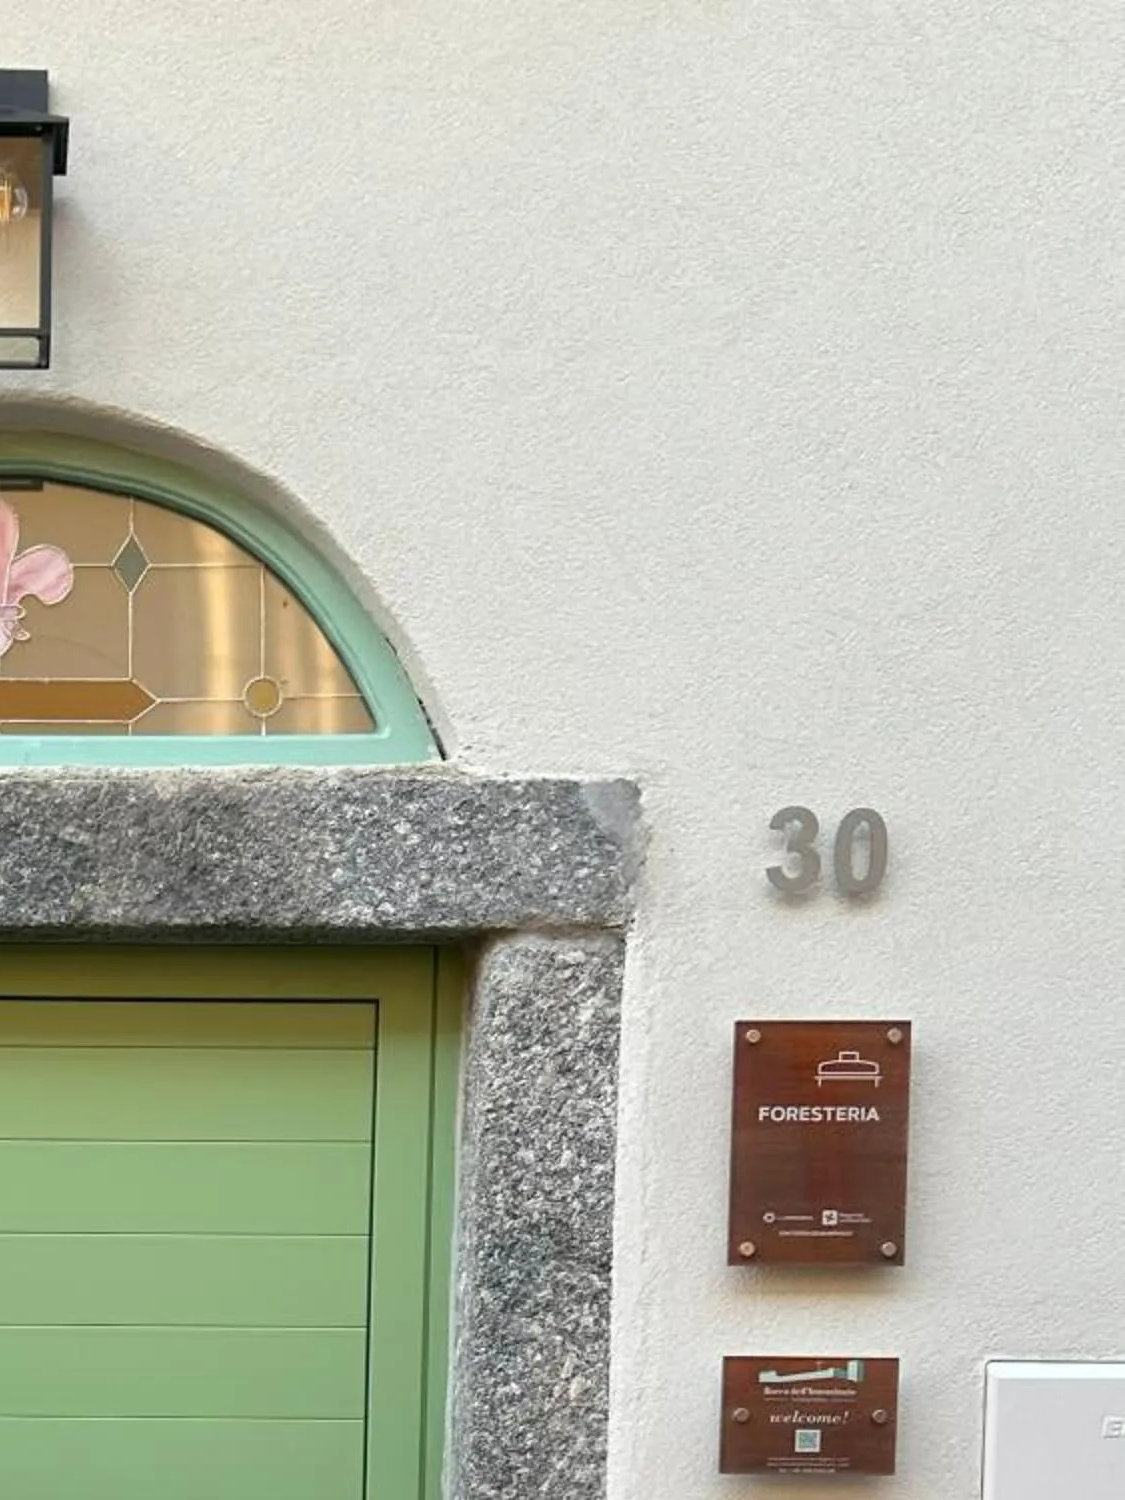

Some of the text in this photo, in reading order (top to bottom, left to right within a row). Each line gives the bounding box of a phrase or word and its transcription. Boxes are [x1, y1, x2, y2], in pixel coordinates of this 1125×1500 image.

[766, 806, 888, 891] 30
[758, 1106, 881, 1121] FORESTERIA
[770, 1410, 850, 1424] welcome!
